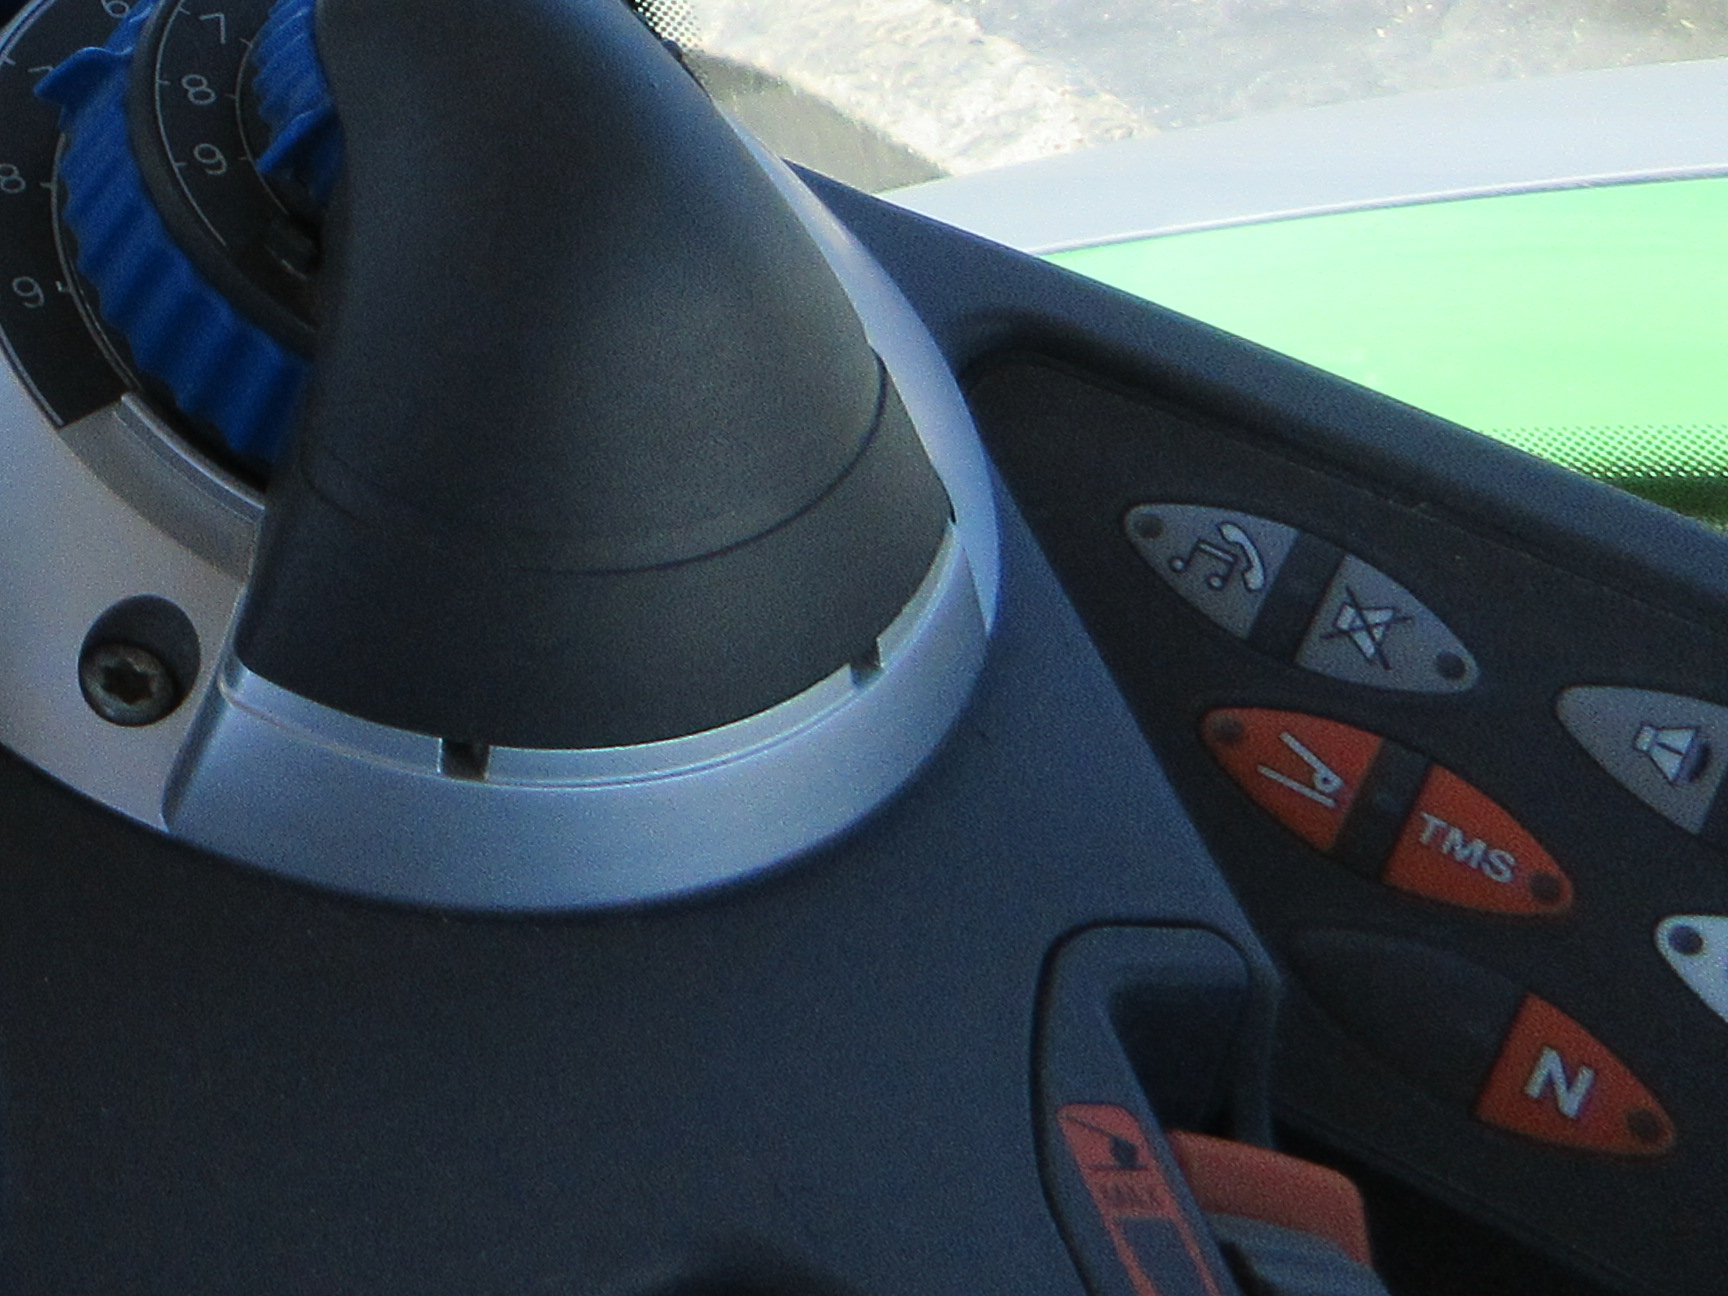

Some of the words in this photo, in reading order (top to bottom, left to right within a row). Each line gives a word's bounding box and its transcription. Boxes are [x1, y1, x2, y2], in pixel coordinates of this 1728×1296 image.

[198, 11, 226, 45] 7
[181, 73, 217, 105] 8
[193, 142, 228, 176] 9
[12, 275, 45, 308] 9
[1415, 812, 1517, 885] TMS
[1523, 1045, 1596, 1120] N
